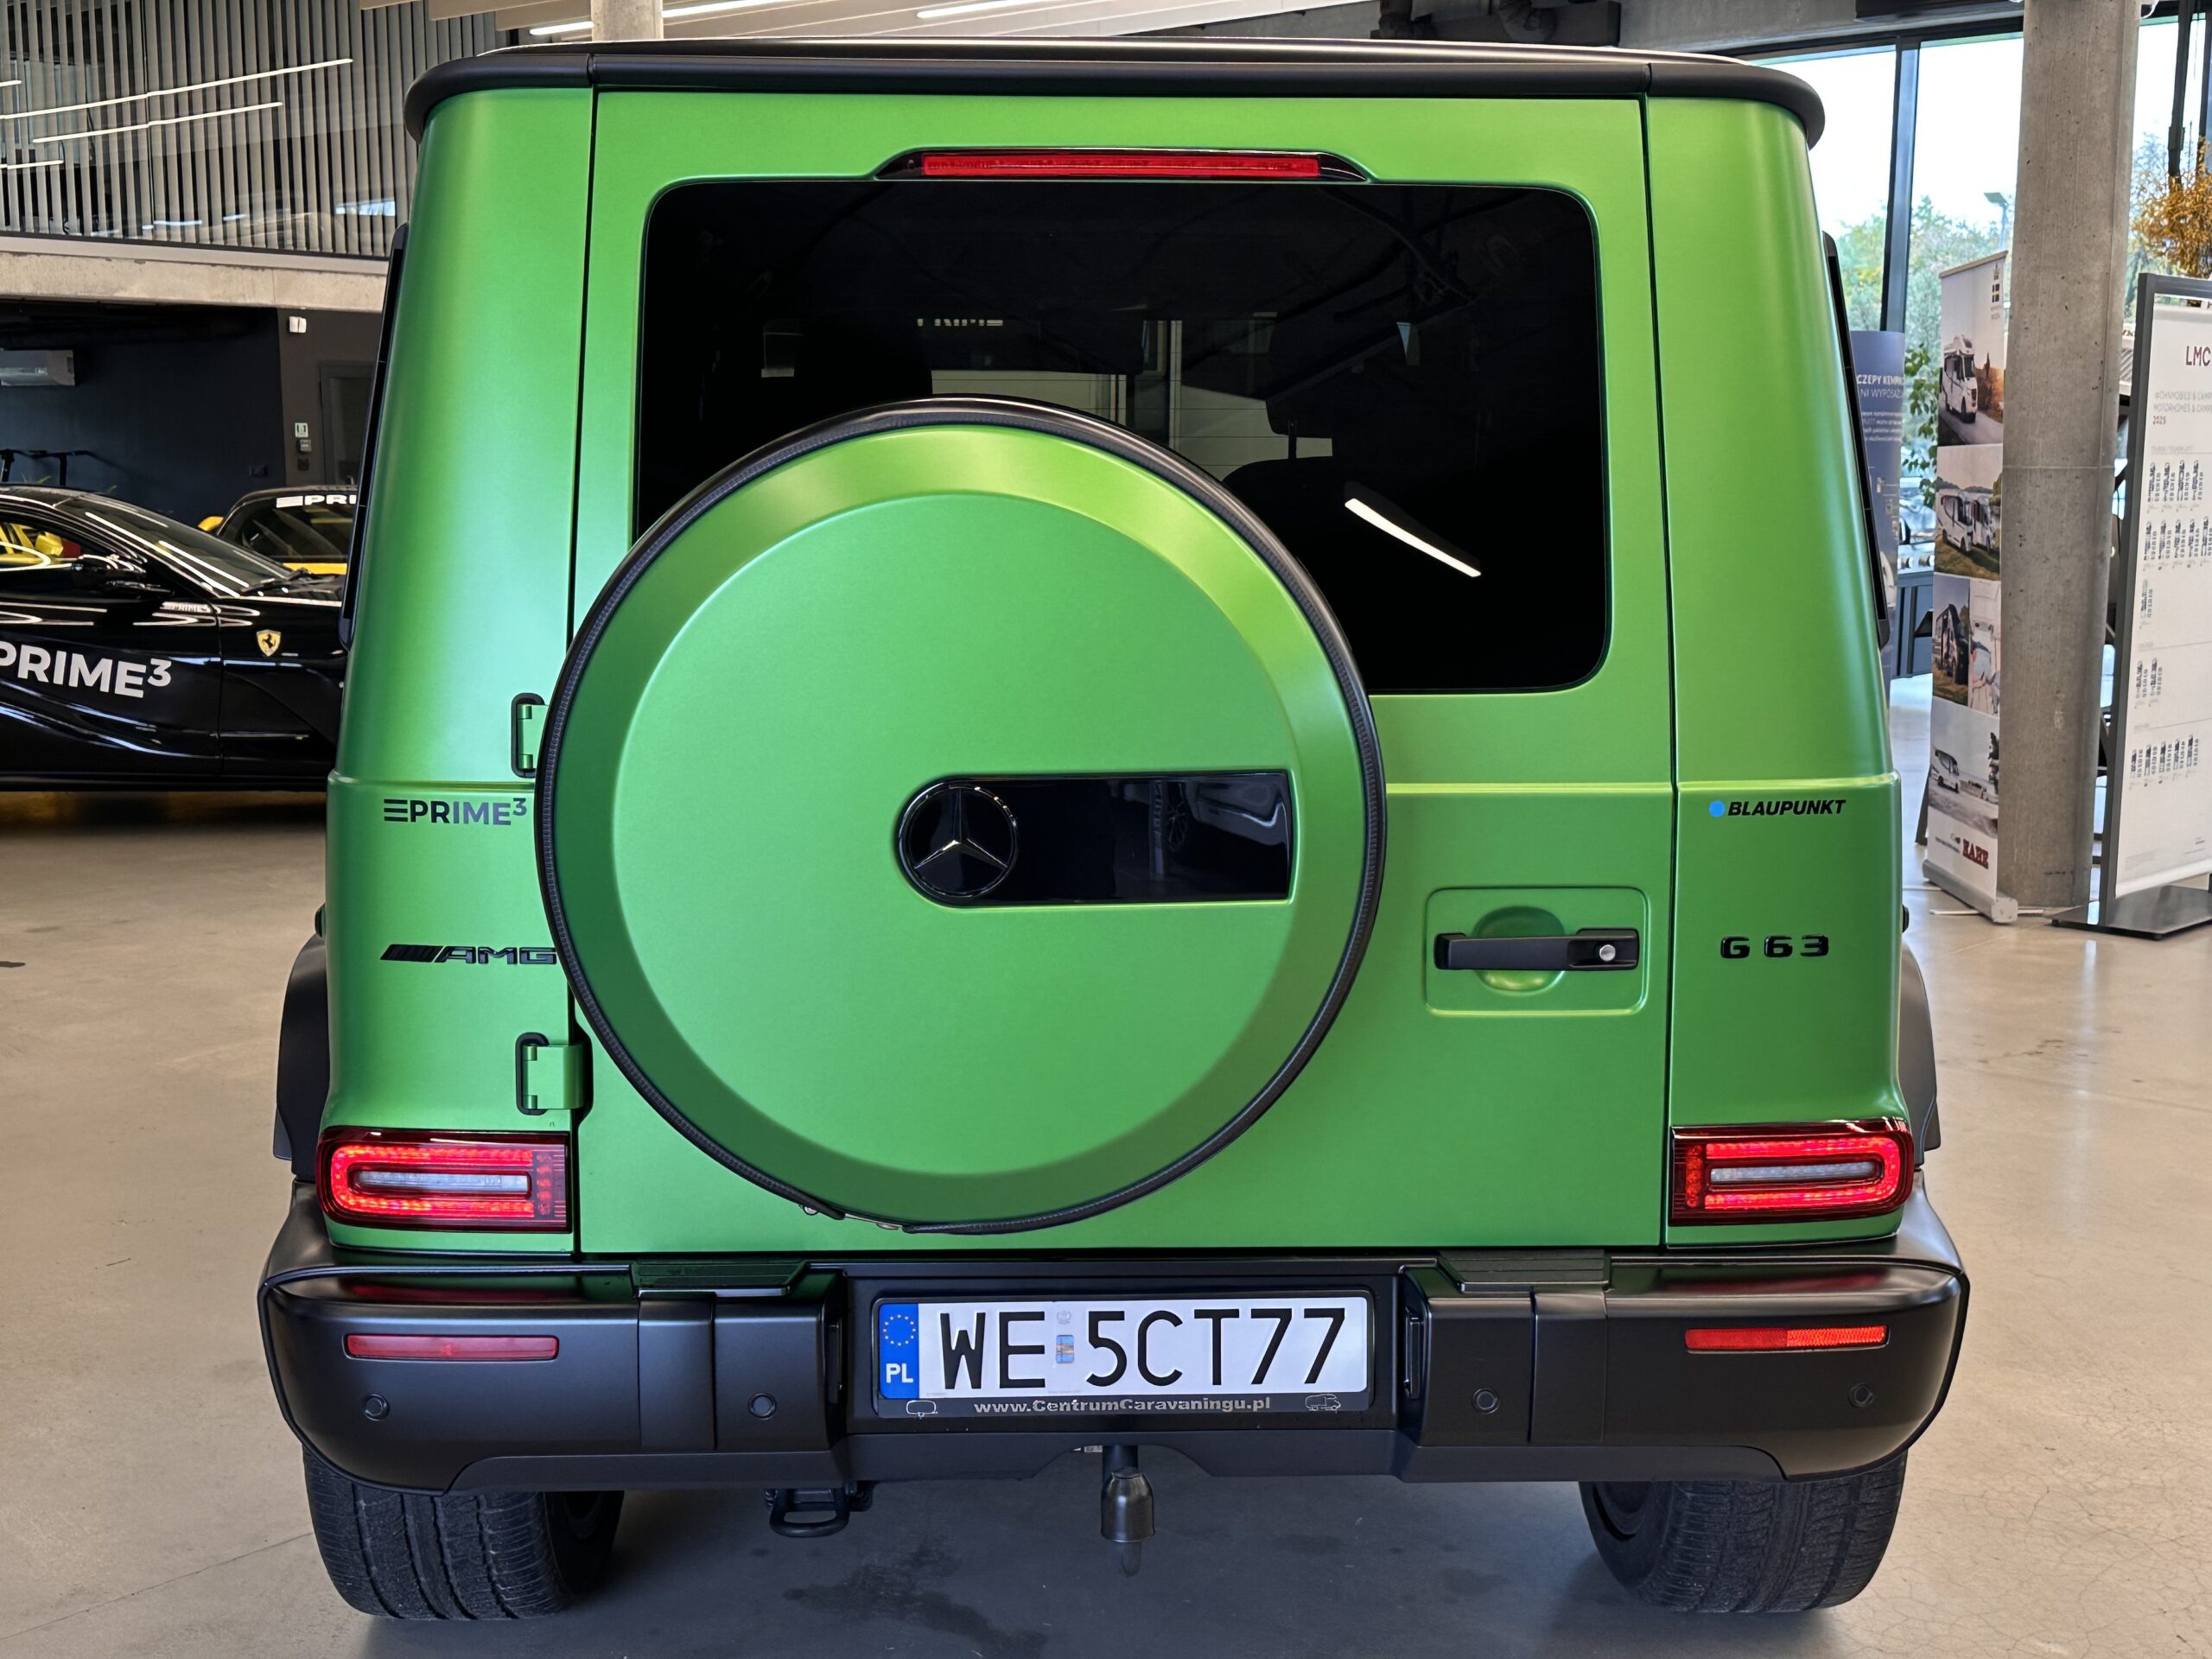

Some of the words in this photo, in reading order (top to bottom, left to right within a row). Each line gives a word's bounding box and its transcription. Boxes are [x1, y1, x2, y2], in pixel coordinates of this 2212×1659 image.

[2185, 346, 2211, 366] LMC
[1727, 799, 1847, 816] BLAUPUNKT
[434, 945, 557, 965] AMG
[1720, 936, 1751, 959] G
[1764, 934, 1829, 958] 63
[940, 1311, 1046, 1389] WE
[1086, 1307, 1345, 1388] 5CT77
[886, 1363, 914, 1384] PL
[974, 1396, 1271, 1414] www.CentrumCaravaningu.pl
